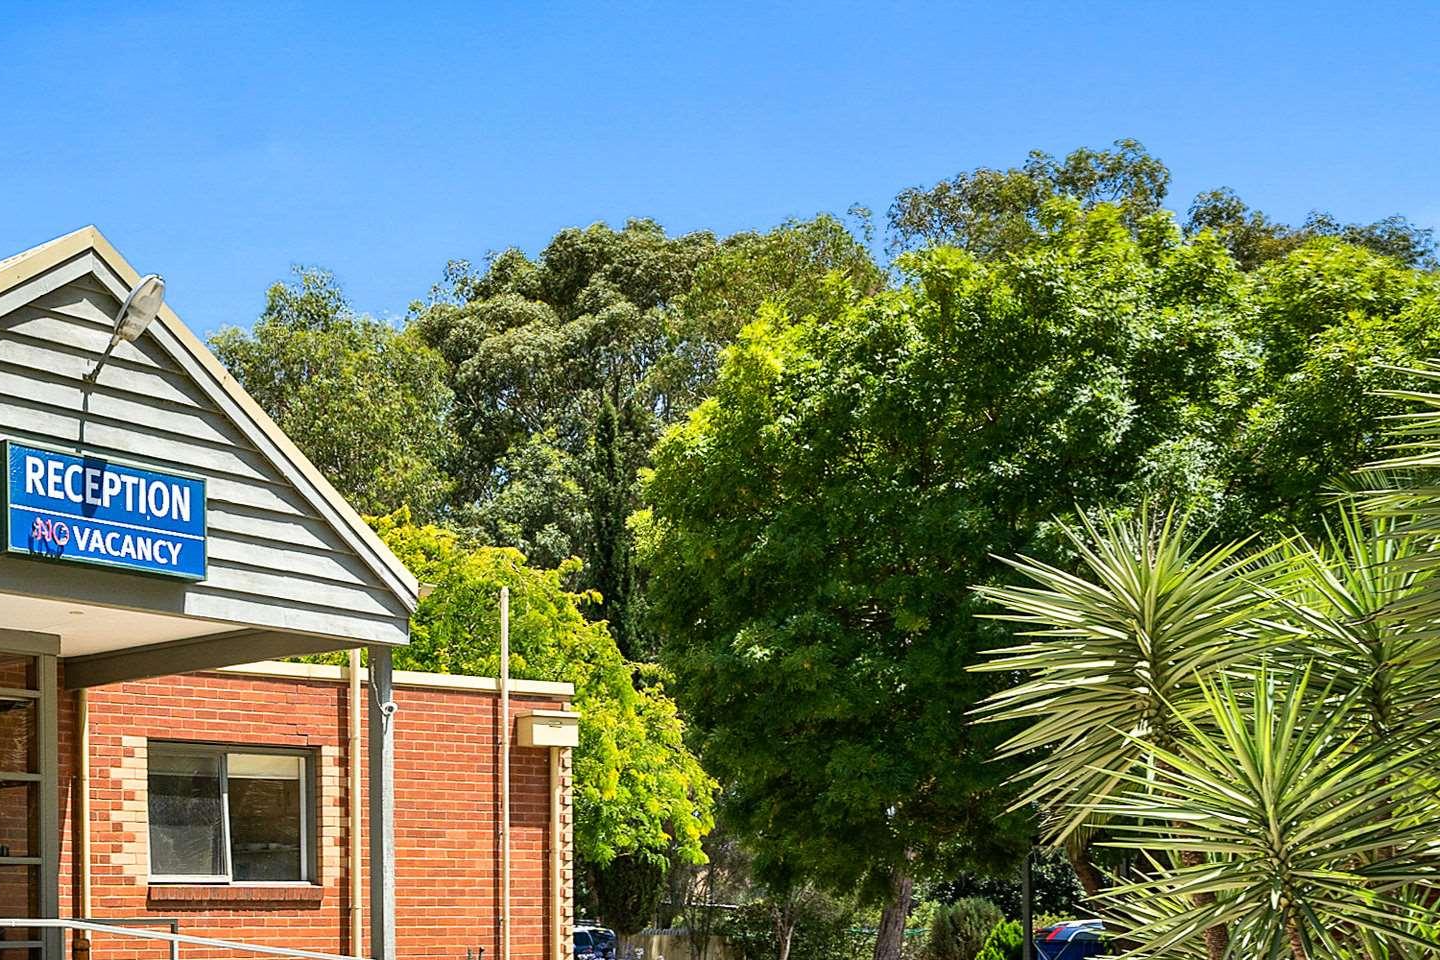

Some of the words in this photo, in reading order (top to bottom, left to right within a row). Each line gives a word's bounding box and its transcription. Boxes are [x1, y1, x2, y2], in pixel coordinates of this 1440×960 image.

[25, 455, 191, 522] RECEPTION
[32, 517, 70, 546] NO
[72, 525, 182, 565] VACANCY
